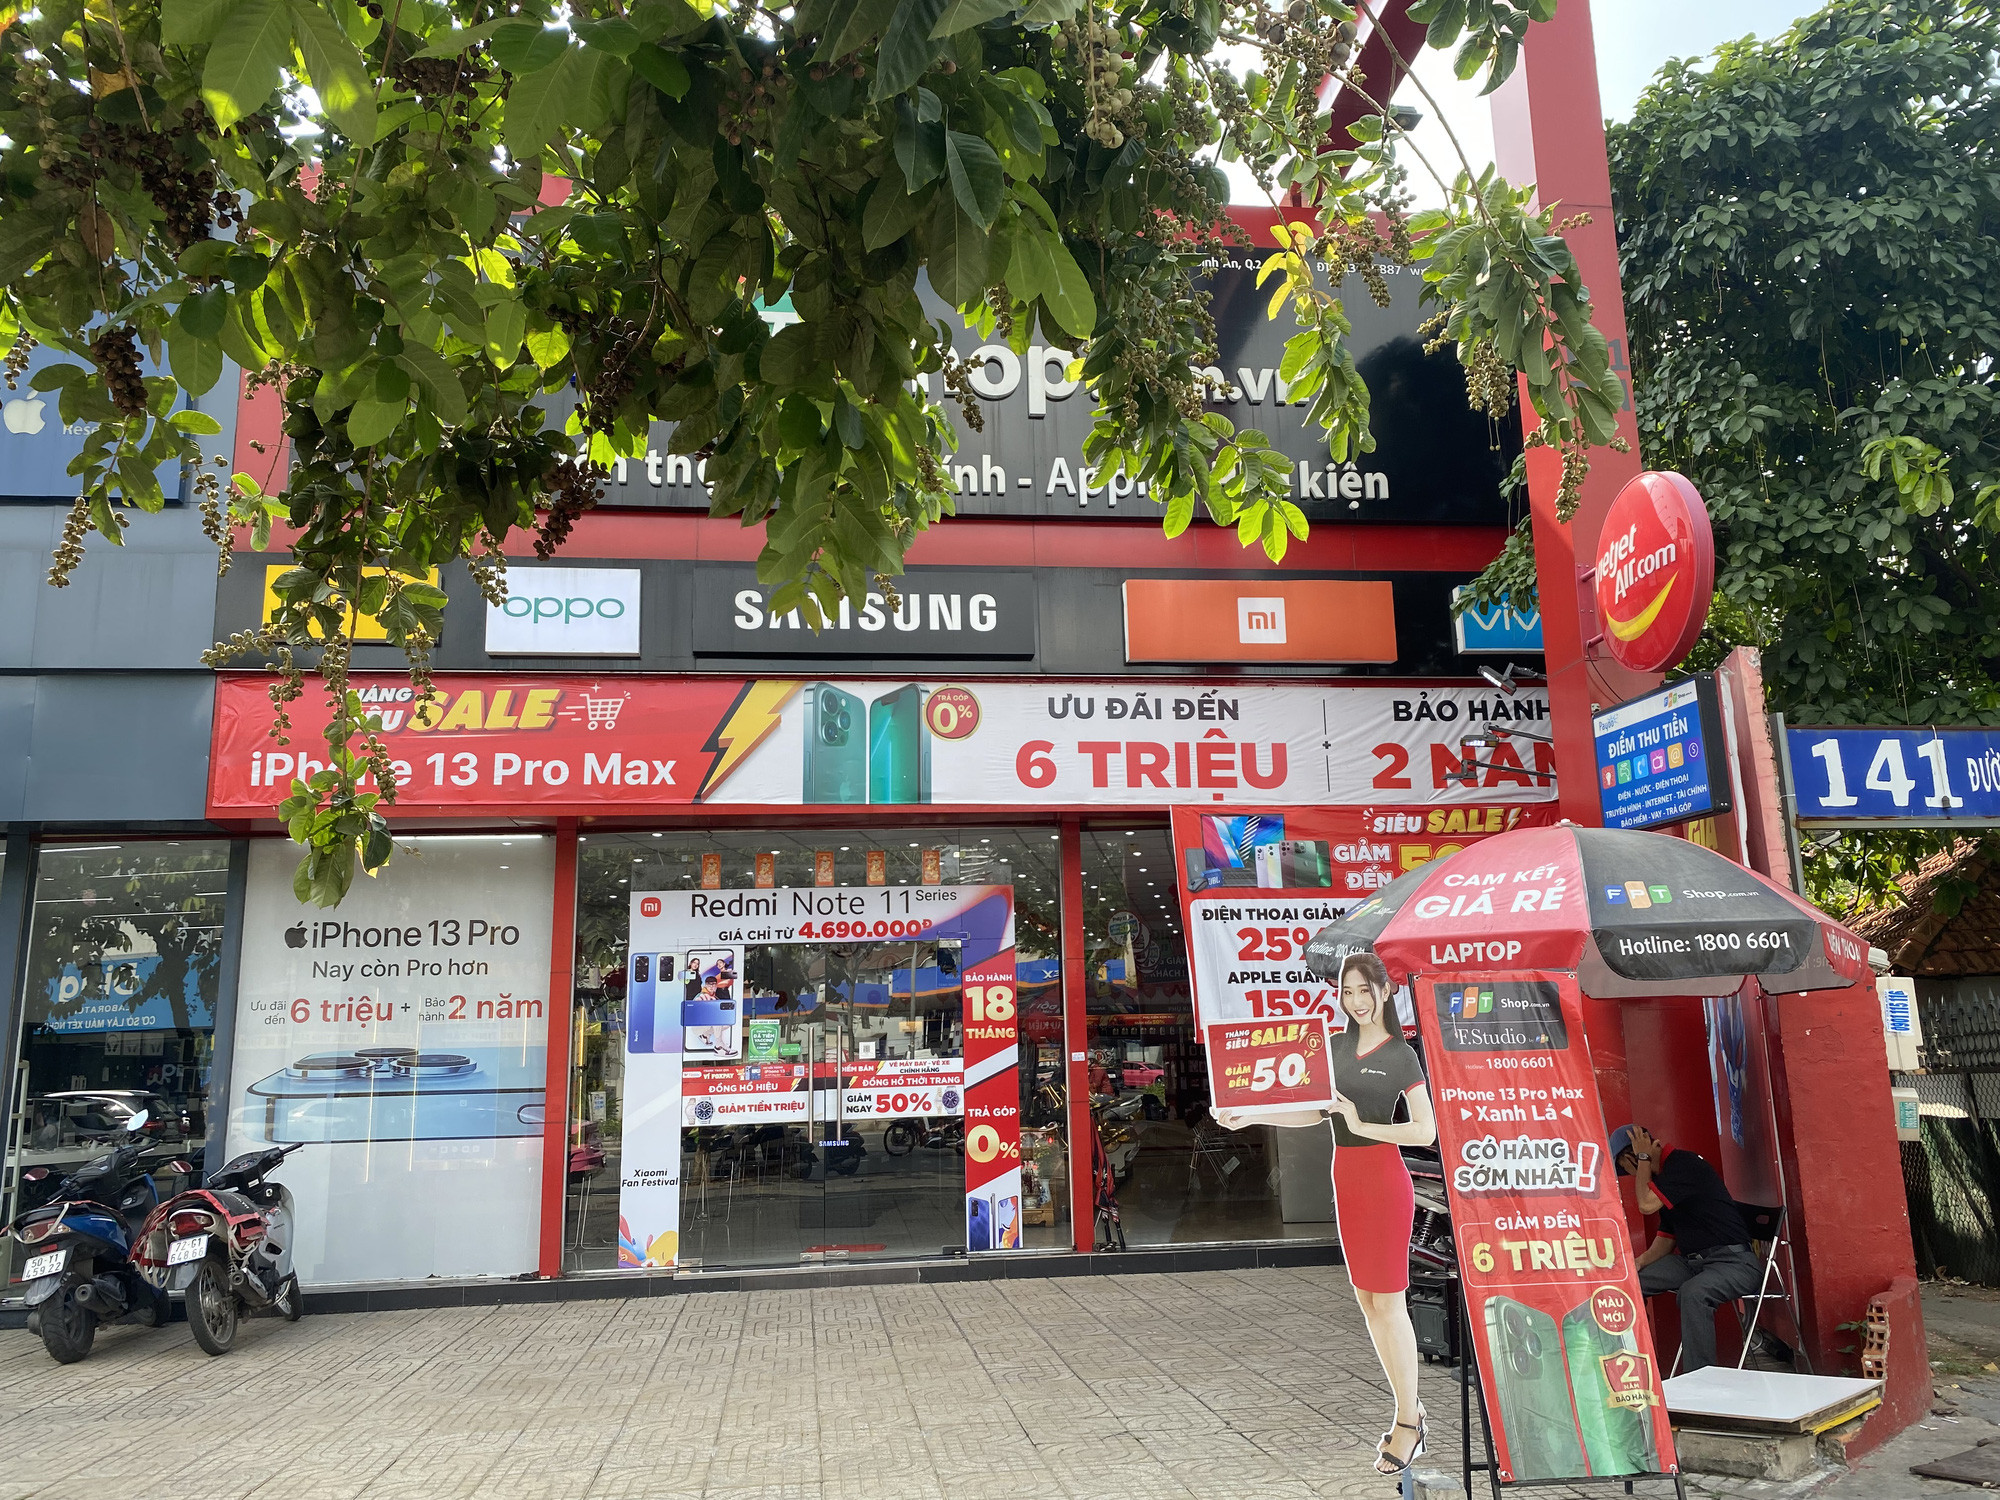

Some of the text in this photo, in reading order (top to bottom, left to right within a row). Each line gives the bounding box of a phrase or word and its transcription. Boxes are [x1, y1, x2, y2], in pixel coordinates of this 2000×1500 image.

[1298, 460, 1390, 511] kiện
[502, 594, 625, 625] oppo
[953, 693, 969, 701] GÓP
[1047, 689, 1239, 720] ƯU ĐÃI ĐẾN
[1393, 690, 1459, 721] BẢO
[407, 688, 559, 732] SALE
[932, 702, 973, 734] 0%
[1608, 711, 1689, 759] ĐIỂM THU TIỀN
[426, 752, 478, 785] 13
[494, 752, 569, 786] Pro
[584, 752, 677, 786] Max
[1015, 728, 1288, 801] 6 TRIỆU
[1371, 743, 1412, 789] 2
[1812, 738, 1964, 808] 141
[1617, 788, 1632, 802] ĐIỆN
[1655, 777, 1670, 791] ĐIỆN
[1669, 773, 1689, 788] THOẠI
[1628, 801, 1642, 814] HÌNH
[1645, 794, 1673, 809] INTERNET
[1676, 789, 1687, 802] TÀI
[1687, 784, 1708, 798] CHÍNH
[1372, 811, 1423, 834] SIÊU
[1620, 816, 1633, 828] BẢO
[1650, 811, 1662, 820] VAY
[1665, 805, 1678, 817] TRẢ
[1678, 802, 1692, 813] GÓP
[1333, 837, 1392, 863] GIẢM
[1443, 862, 1559, 888] CAM KẾT
[690, 888, 957, 919] Redmi Note 11 Series
[1413, 877, 1567, 920] GIÁ RẺ
[1202, 904, 1243, 923] ĐIỆN
[1246, 907, 1299, 924] THOẠI
[1302, 902, 1346, 920] GIẢM
[312, 919, 520, 949] iPhone 13 Pro
[718, 928, 744, 943] GIÁ
[746, 926, 772, 942] CHỈ
[775, 925, 795, 940] TỪ
[1618, 931, 1790, 957] Hotline: 1800 6601
[1430, 940, 1522, 965] LAPTOP
[312, 958, 489, 982] Nay còn Pro hơn
[965, 971, 1013, 982] BẢO HÀNH
[1228, 971, 1281, 985] APPLE
[250, 1000, 287, 1012] Ưu đãi
[290, 995, 394, 1029] 6 triệu
[425, 996, 446, 1008] Bảo
[448, 992, 543, 1021] 2 năm
[964, 985, 1015, 1022] 18
[264, 1013, 286, 1026] đến
[418, 1010, 445, 1022] hành
[966, 1025, 1016, 1040] THÁNG
[1225, 1029, 1250, 1039] THÁNG
[1457, 1028, 1526, 1045] F.Studio
[1225, 1038, 1249, 1050] SIÊU
[858, 1064, 875, 1072] BÁN
[1225, 1063, 1251, 1076] GIẢM
[1486, 1056, 1554, 1069] 1800 6601
[708, 1081, 778, 1093] ĐỒNG HỒ HIỆU
[862, 1075, 960, 1087] ĐỒNG HỒ THỜI TRANG
[1228, 1075, 1249, 1089] ĐẾN
[847, 1092, 872, 1103] GIẢM
[875, 1092, 932, 1113] 50%
[1441, 1086, 1585, 1102] iPhone 13 Pro Max
[718, 1100, 805, 1113] GIẢM TIỀN TRIỆU
[846, 1105, 872, 1114] NGAY
[968, 1106, 1017, 1118] TRẢ GÓP
[1475, 1103, 1558, 1122] Xanh Lá
[966, 1124, 1020, 1164] 0%
[1465, 1134, 1566, 1160] CÓ HÀNG
[621, 1176, 679, 1188] Fan Festival
[633, 1168, 668, 1178] Xiaomi
[1457, 1160, 1577, 1188] SỚM NHẤT
[1494, 1208, 1582, 1231] GIẢM ĐẾN
[175, 1237, 202, 1252] 72-G1
[1472, 1230, 1616, 1277] 6 TRIỆU
[1597, 1295, 1625, 1309] MÀU
[1602, 1310, 1626, 1323] MỚI
[1615, 1355, 1640, 1384] 2
[1615, 1394, 1631, 1403] BẢO
